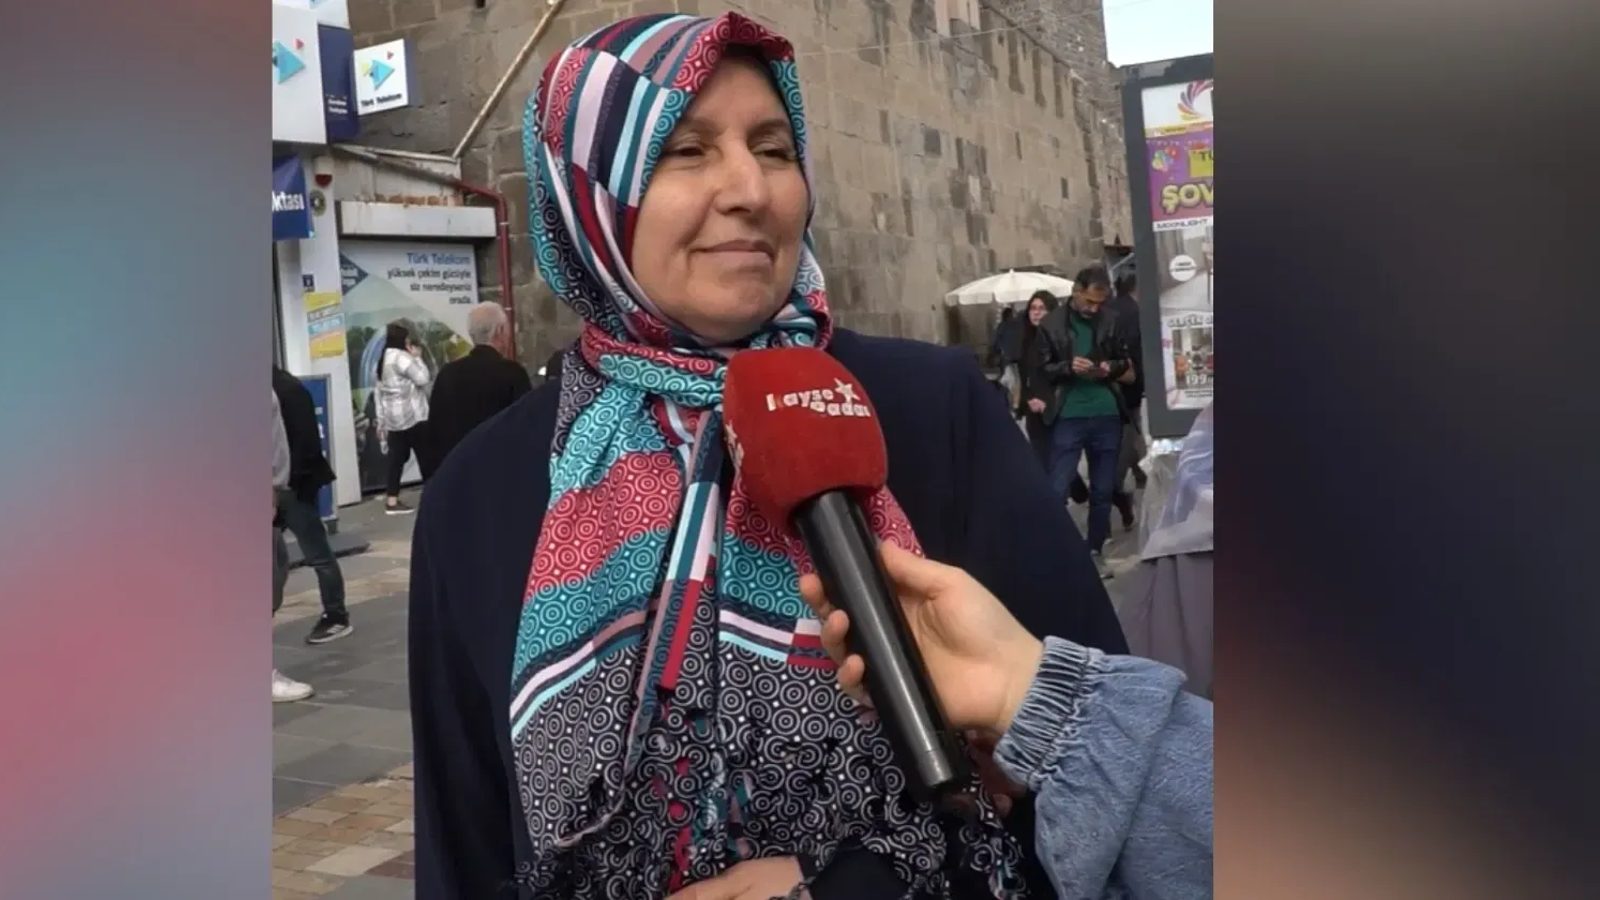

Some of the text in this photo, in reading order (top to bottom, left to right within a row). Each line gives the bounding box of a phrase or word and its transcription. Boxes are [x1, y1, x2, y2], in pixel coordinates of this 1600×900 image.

[272, 191, 305, 211] ktası
[406, 252, 471, 265] Türk Telekom
[387, 267, 415, 280] yüksek
[417, 267, 440, 279] çekim
[410, 283, 420, 291] siz
